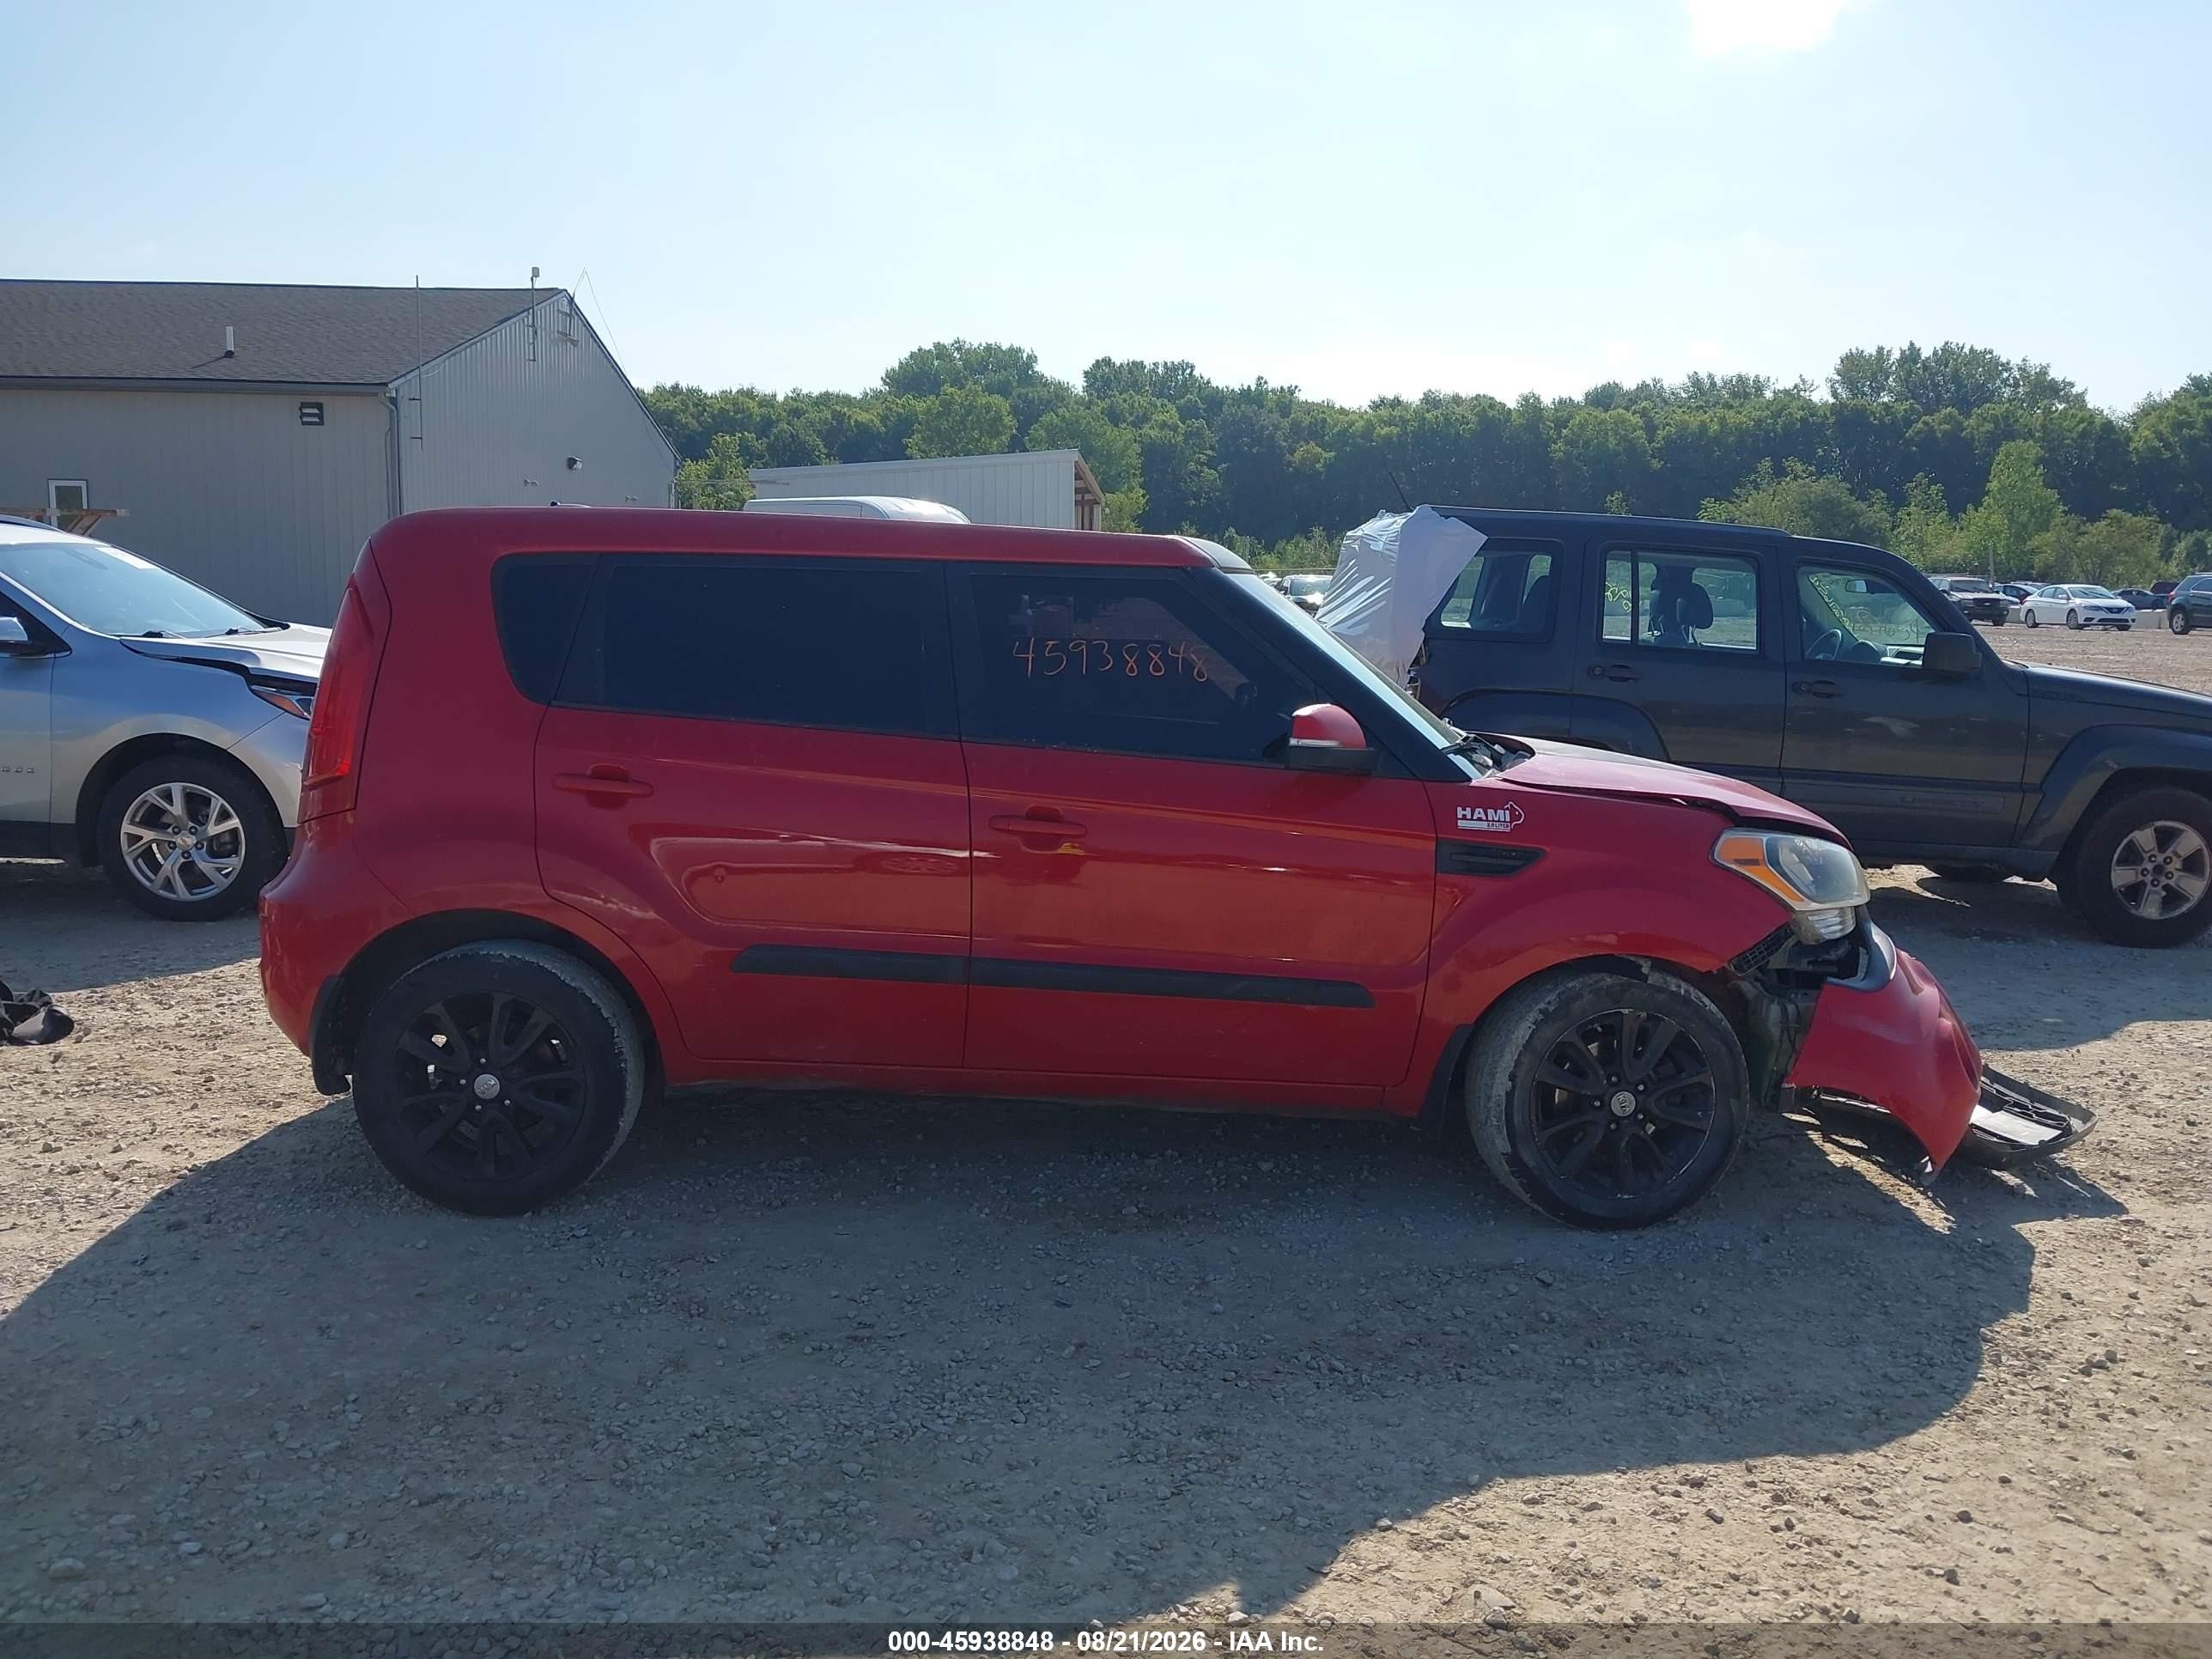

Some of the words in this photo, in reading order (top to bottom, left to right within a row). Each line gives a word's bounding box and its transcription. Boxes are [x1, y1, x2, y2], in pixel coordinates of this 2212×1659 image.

[1012, 637, 1207, 682] 45938848
[1456, 806, 1510, 822] HAMI
[1616, 1092, 1630, 1114] KIA
